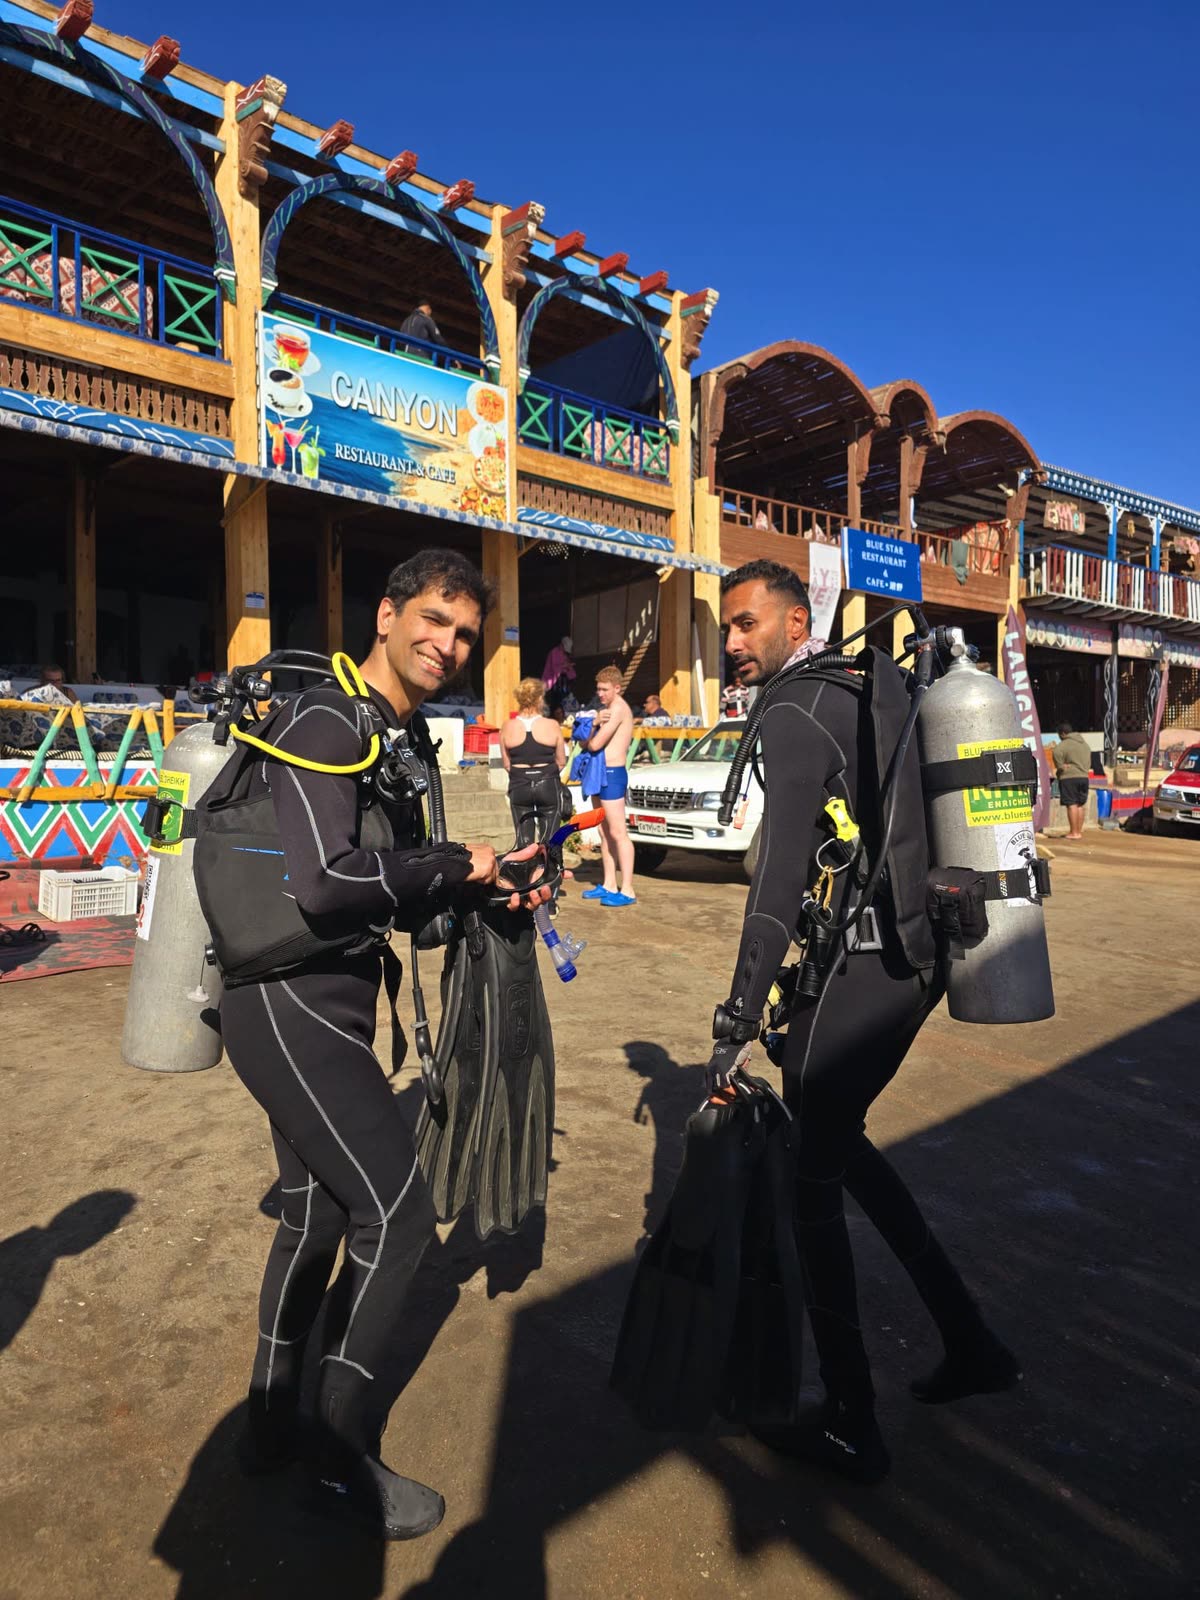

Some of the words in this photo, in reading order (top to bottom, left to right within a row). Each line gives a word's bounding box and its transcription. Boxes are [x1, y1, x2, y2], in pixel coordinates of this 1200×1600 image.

[330, 370, 458, 436] CANYON
[335, 442, 413, 474] RESTAURANT
[416, 464, 426, 477] &
[426, 464, 456, 484] CAFE
[865, 539, 885, 548] BLUE
[885, 543, 904, 556] STAR
[861, 551, 907, 568] RESTAURANT
[865, 577, 885, 588] CAFE
